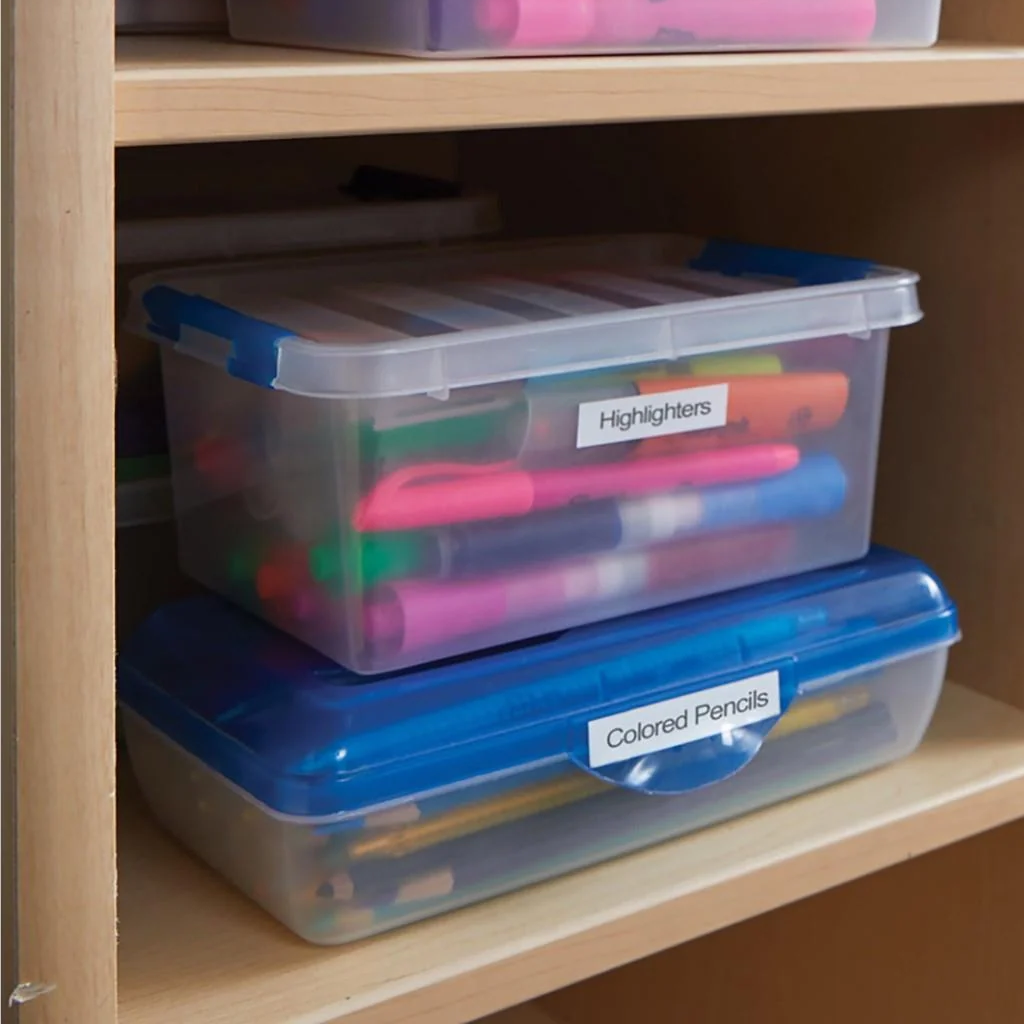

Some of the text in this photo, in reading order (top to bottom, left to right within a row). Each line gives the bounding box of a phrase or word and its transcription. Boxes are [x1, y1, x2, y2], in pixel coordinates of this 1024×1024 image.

[600, 400, 711, 431] Highlighters
[607, 690, 769, 748] Colored Pencils
